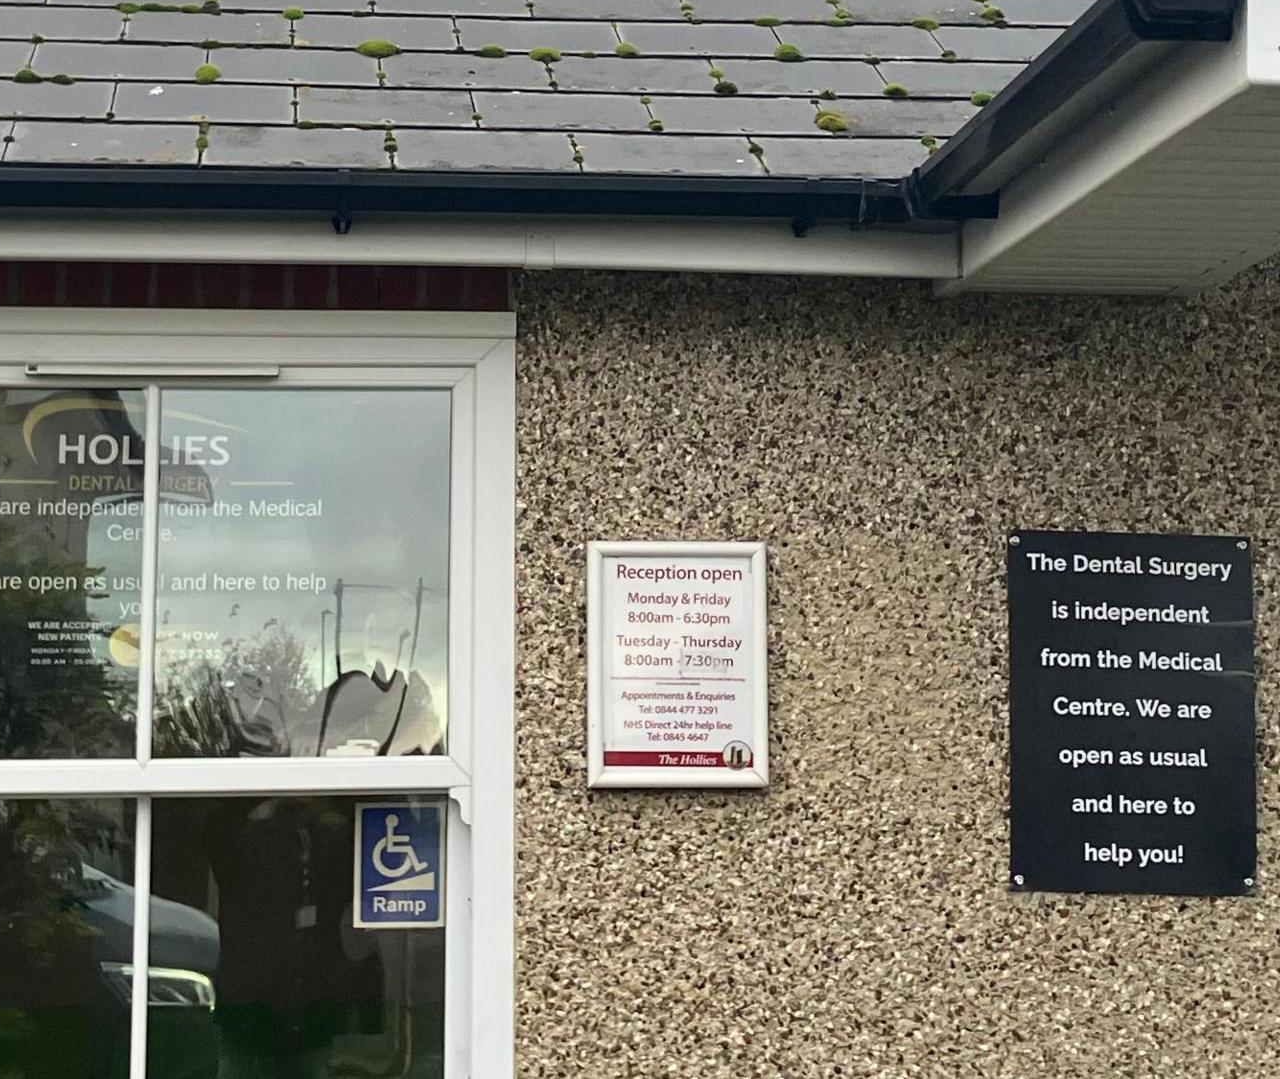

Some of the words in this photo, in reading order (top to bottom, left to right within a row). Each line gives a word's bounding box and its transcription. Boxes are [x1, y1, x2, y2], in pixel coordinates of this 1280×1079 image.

[69, 476, 135, 492] DENTAL
[0, 501, 31, 516] are
[164, 499, 207, 517] from
[213, 500, 243, 516] the
[249, 499, 322, 517] Medical
[107, 524, 177, 541] Cene.
[616, 564, 697, 583] Reception
[701, 569, 743, 584] open
[1026, 552, 1067, 572] The
[1072, 554, 1144, 576] Dental
[1148, 556, 1232, 582] Surgery
[28, 575, 77, 594] open
[83, 575, 107, 590] as
[113, 573, 165, 591] usul
[171, 573, 207, 591] and
[213, 573, 257, 591] here
[262, 574, 280, 591] to
[286, 573, 327, 595] help
[627, 592, 679, 607] Monday
[681, 593, 691, 605] &
[693, 593, 732, 608] Friday
[628, 612, 674, 624] 8:00am
[683, 612, 731, 627] 6:30pm
[1052, 600, 1069, 619] is
[1074, 601, 1210, 626] independent
[28, 621, 41, 630] WE
[44, 621, 60, 630] ARE
[38, 632, 58, 641] NEW
[182, 631, 219, 641] NOW
[616, 634, 671, 650] Tuesday
[681, 636, 743, 651] Thursday
[624, 654, 673, 666] 8:00am
[685, 655, 734, 670] 7:30pm
[1040, 648, 1091, 669] from
[1097, 650, 1133, 670] the
[1138, 651, 1223, 672] Medical
[622, 691, 685, 704] Appointments
[686, 692, 695, 700] &
[695, 692, 736, 703] Enquiries
[638, 705, 653, 715] Tel:
[679, 706, 695, 715] 477
[1053, 696, 1131, 717] Centre.
[1136, 699, 1171, 719] We
[1176, 702, 1212, 719] are
[623, 720, 643, 729] NHS
[644, 720, 671, 730] Direct
[695, 720, 715, 732] help
[716, 720, 733, 730] line
[647, 732, 663, 741] Tel:
[658, 754, 679, 766] The
[680, 754, 718, 766] Hollies
[1059, 749, 1114, 768] open
[1119, 750, 1144, 767] as
[1149, 748, 1208, 768] usual
[1072, 795, 1113, 814] and
[1119, 795, 1168, 816] here
[1173, 797, 1196, 816] to
[1084, 842, 1133, 868] help
[1138, 844, 1184, 868] you!
[373, 896, 427, 916] Ramp
